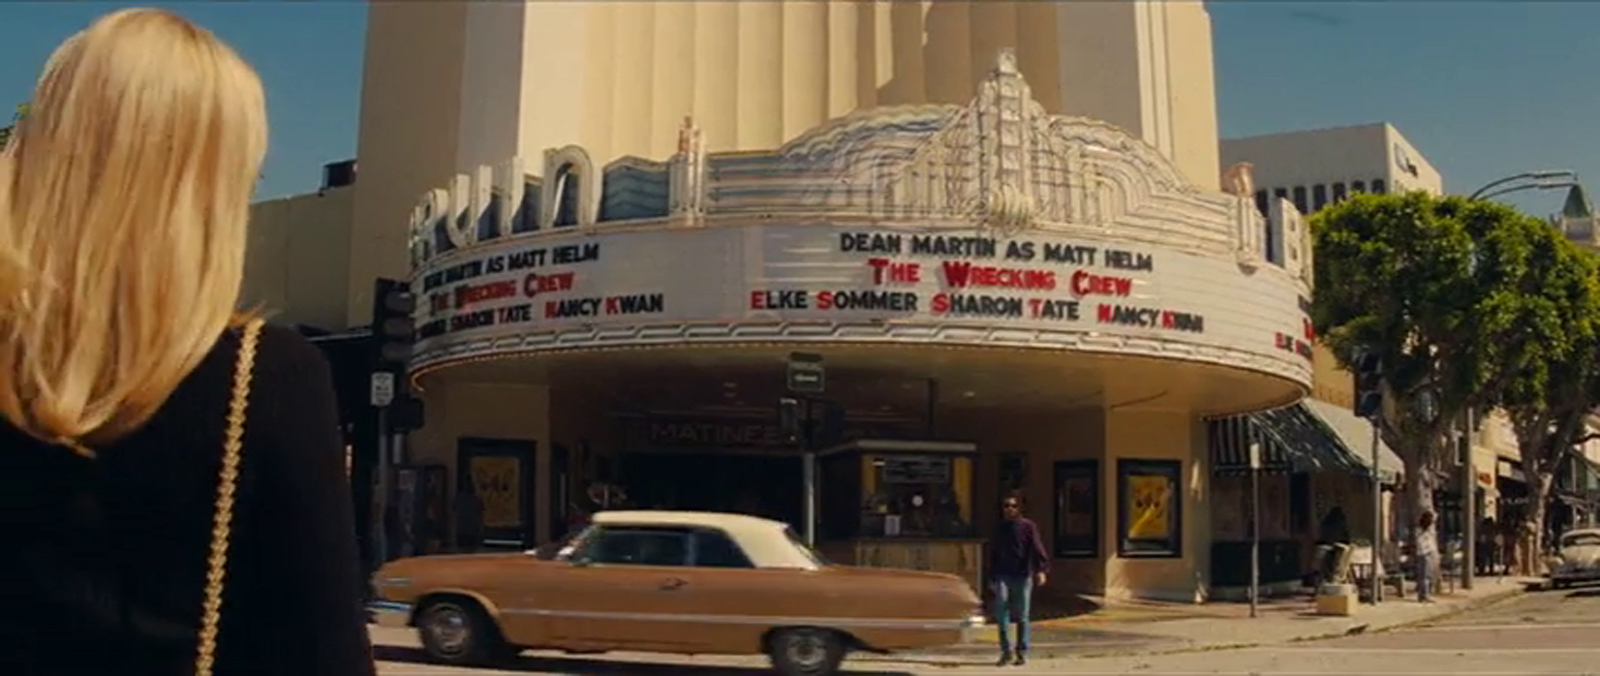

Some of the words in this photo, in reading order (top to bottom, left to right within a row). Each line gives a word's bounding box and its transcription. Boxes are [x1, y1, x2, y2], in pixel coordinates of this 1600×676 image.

[409, 145, 600, 262] RUIN
[486, 256, 504, 274] AS
[508, 249, 546, 270] MATT
[552, 244, 599, 264] HELM
[840, 233, 900, 252] DEAN
[912, 235, 996, 256] MARTIN
[1006, 240, 1035, 259] AS
[1044, 243, 1096, 265] MATT
[1105, 249, 1153, 272] HELM
[524, 272, 574, 297] CREW
[869, 258, 920, 284] THE
[943, 261, 1055, 289] WRECKING
[1071, 270, 1132, 297] CREW
[500, 304, 531, 323] TATE
[545, 299, 602, 318] NANCY
[606, 294, 663, 315] KWAN
[751, 291, 808, 309] ELKE
[817, 291, 918, 311] SOMMER
[933, 294, 1022, 316] SHARON
[1029, 299, 1079, 319] TATE
[1098, 304, 1160, 328] NANCY
[1162, 311, 1204, 333] KWAN
[650, 423, 797, 444] MATINEE
